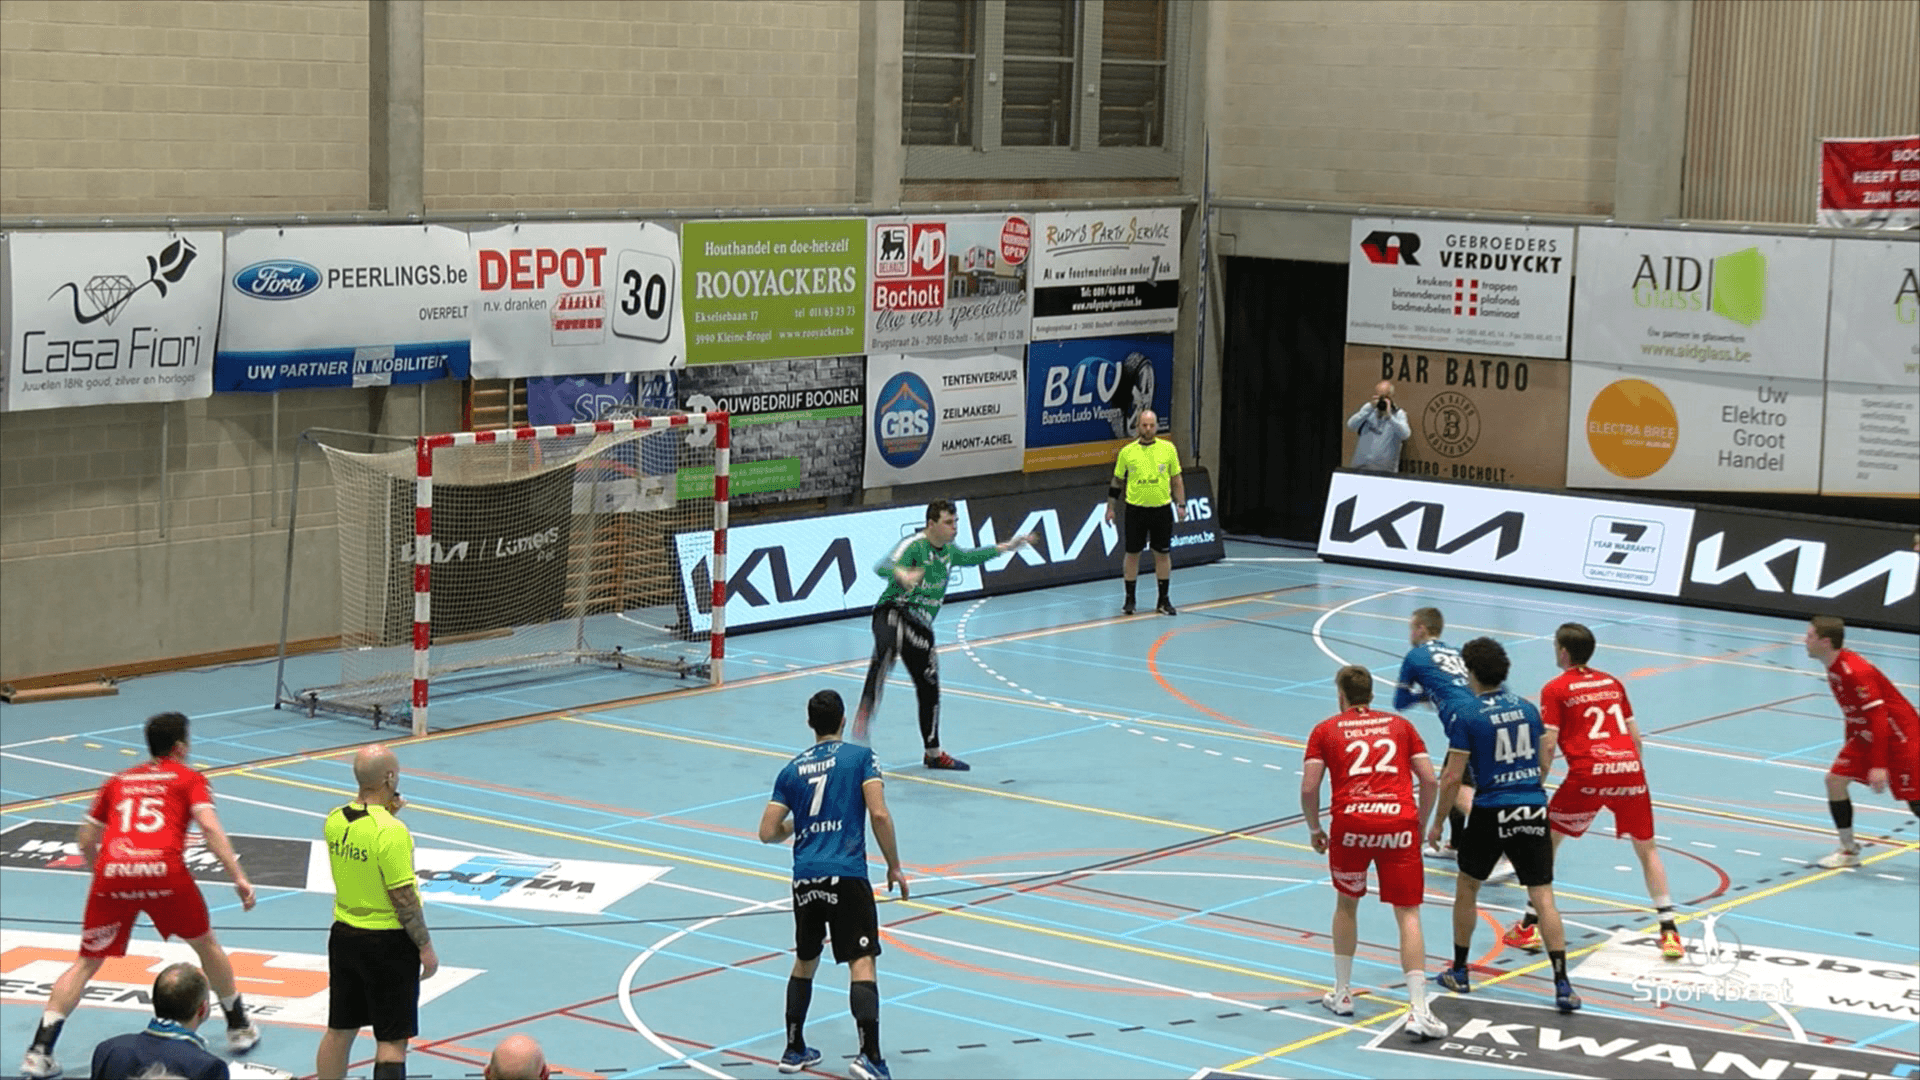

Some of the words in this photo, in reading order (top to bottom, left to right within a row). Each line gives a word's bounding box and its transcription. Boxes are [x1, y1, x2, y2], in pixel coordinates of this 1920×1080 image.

[1091, 220, 1125, 244] PARTY
[1126, 215, 1170, 245] SERVICE
[704, 240, 771, 256] Houthandel
[773, 242, 787, 254] en
[912, 228, 945, 271] AD
[1445, 234, 1557, 253] GEBROEDERS
[478, 247, 607, 291] DEPOT
[1439, 251, 1562, 274] VERDUYCKT
[1631, 254, 1702, 292] AID
[251, 265, 305, 294] Ford
[327, 264, 468, 289] PEERLINGS.be
[695, 266, 856, 299] ROOYACKERS
[1417, 276, 1453, 287] keukens
[1482, 281, 1518, 293] trappen
[505, 297, 547, 312] dranken
[621, 268, 667, 320] 30
[876, 283, 940, 309] Bocholt
[1392, 288, 1452, 301] binnendeuren
[1480, 294, 1520, 307] plafonds
[418, 306, 468, 321] OVERPELT
[950, 289, 1026, 331] specialist
[1391, 301, 1451, 315] badmeubelen
[1479, 307, 1520, 319] laminaat
[943, 333, 968, 344] Bocholt
[22, 331, 119, 374] Casa
[128, 326, 202, 369] Fiori
[1640, 343, 1752, 363] www.aidglass.be
[247, 364, 276, 380] UW
[279, 360, 349, 378] PARTNER
[352, 358, 367, 375] IN
[942, 369, 1018, 386] TENTENVERHUUR
[1382, 352, 1428, 384] BAR
[1445, 357, 1529, 392] BATOO
[21, 379, 62, 393] Juwelen
[114, 374, 141, 386] zilver
[143, 375, 156, 386] en
[158, 372, 197, 385] horloges
[806, 387, 859, 408] BOONEN
[1757, 385, 1789, 404] Uw
[942, 403, 1001, 420] ZEILMAKERIJ
[1041, 411, 1072, 426] Banden
[1072, 407, 1092, 422] Ludo
[1722, 405, 1787, 427] Elektro
[881, 408, 930, 439] GBS
[1589, 421, 1641, 436] ELECTRA
[1643, 425, 1675, 440] BREE
[941, 433, 1013, 451] HAMONT-ACHEL
[1733, 428, 1786, 450] Groot
[1718, 449, 1785, 472] Handel
[1329, 494, 1525, 561] KIA
[1594, 540, 1613, 549] YEAR
[1614, 542, 1656, 554] WARRANTY
[1690, 531, 1919, 606] KIA
[1583, 703, 1628, 739] 21
[1494, 722, 1536, 764] 44
[1344, 739, 1398, 776] 22
[1592, 760, 1641, 775] BRUNO
[808, 773, 828, 817] 7
[115, 797, 165, 833] 15
[1343, 802, 1401, 815] BRUNO
[1341, 831, 1413, 848] BRUNO
[1438, 1042, 1528, 1060] PELT
